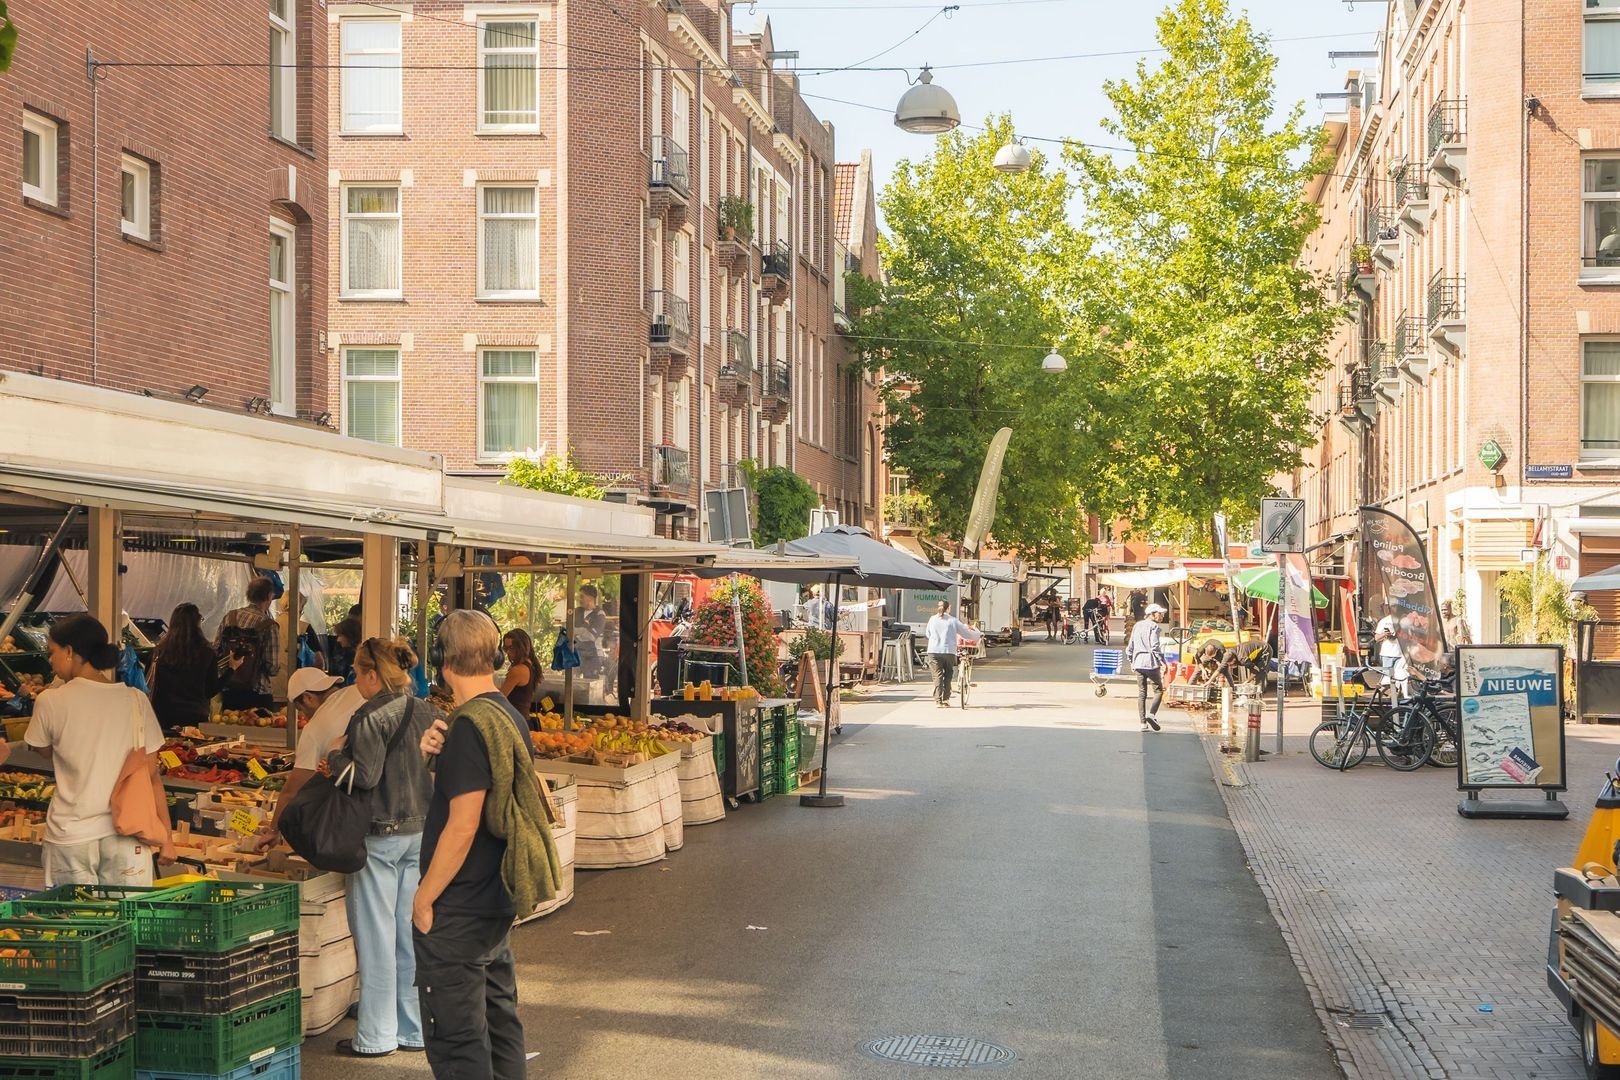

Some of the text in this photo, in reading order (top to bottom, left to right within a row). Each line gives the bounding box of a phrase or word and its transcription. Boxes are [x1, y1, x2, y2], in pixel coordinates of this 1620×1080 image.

[1487, 679, 1552, 691] NIEUWE
[148, 969, 195, 979] ALVANTHO 1996
